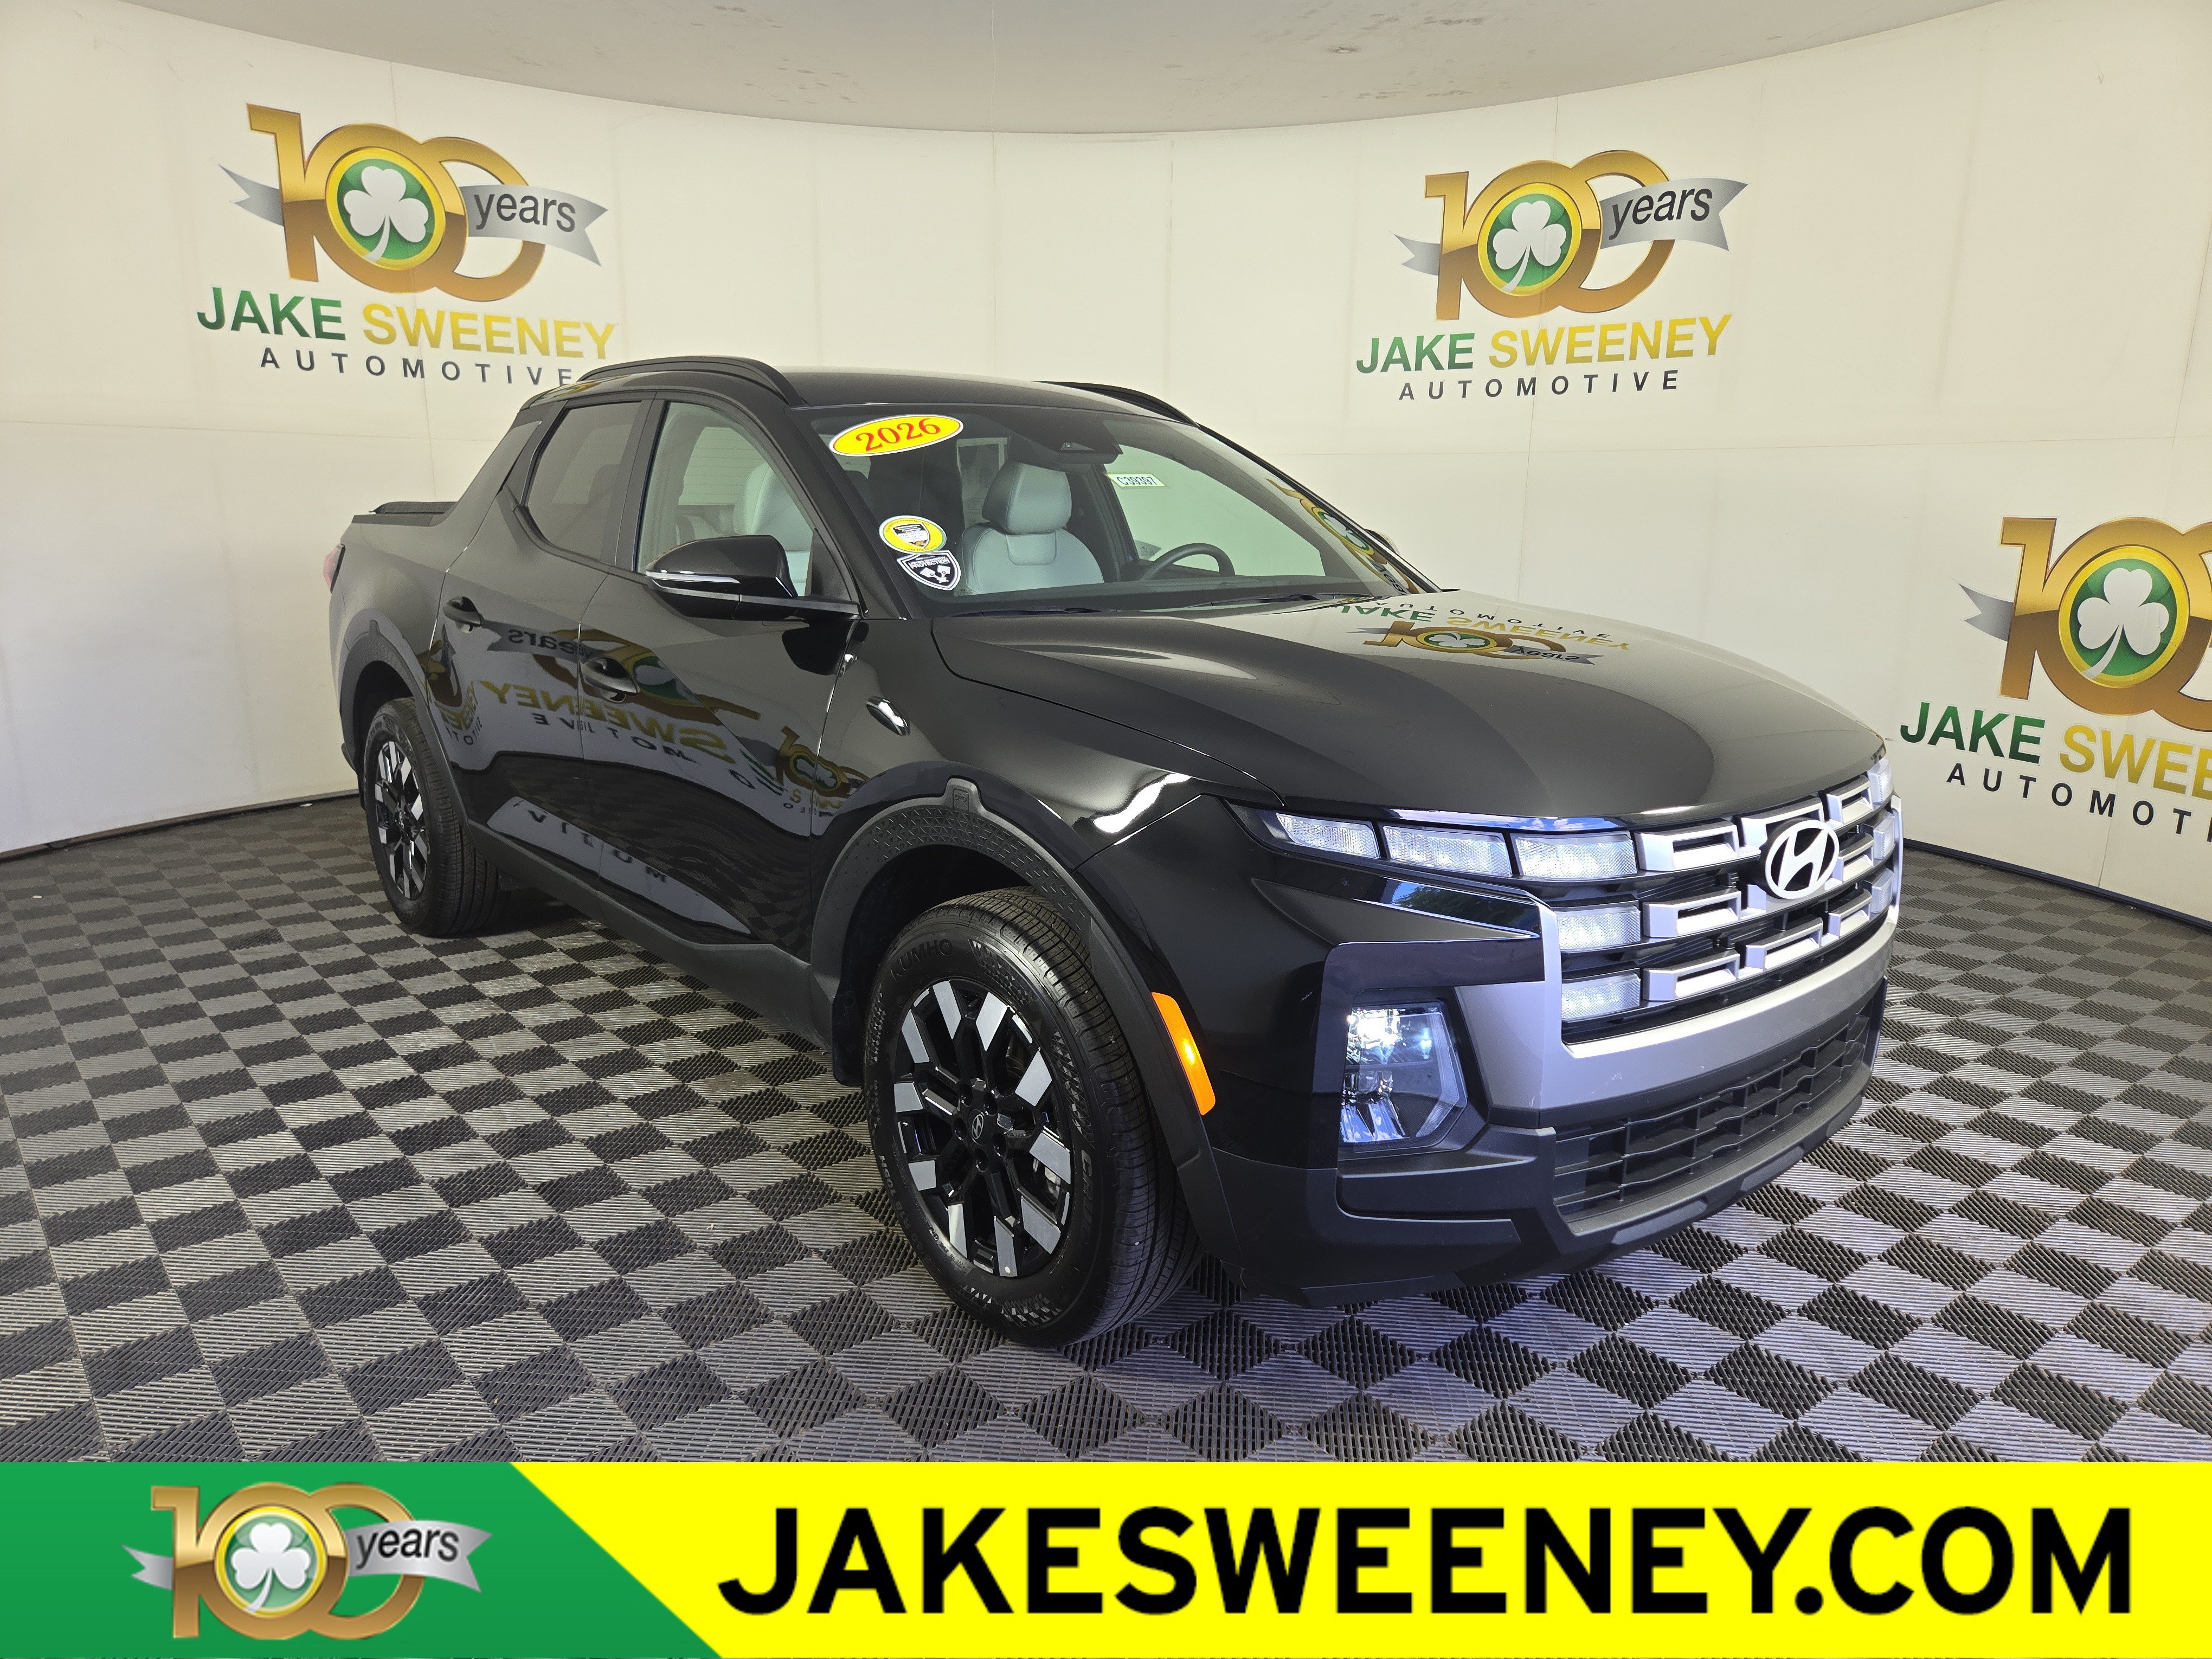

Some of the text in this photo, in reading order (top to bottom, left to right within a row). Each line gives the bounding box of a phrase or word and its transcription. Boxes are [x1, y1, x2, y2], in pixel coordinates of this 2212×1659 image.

[247, 104, 546, 301] 100
[474, 192, 577, 233] years
[1609, 188, 1712, 240] years
[1425, 150, 1675, 320] 100
[197, 287, 616, 359] JAKE SWEENEY
[1356, 314, 1733, 374] JAKE SWEENEY
[260, 347, 572, 386] AUTOMOTIVE
[1398, 370, 1679, 401] AUTOMOTIVE
[856, 417, 941, 452] 2026
[1116, 477, 1158, 485] C39397
[1900, 702, 2046, 764] JAKE
